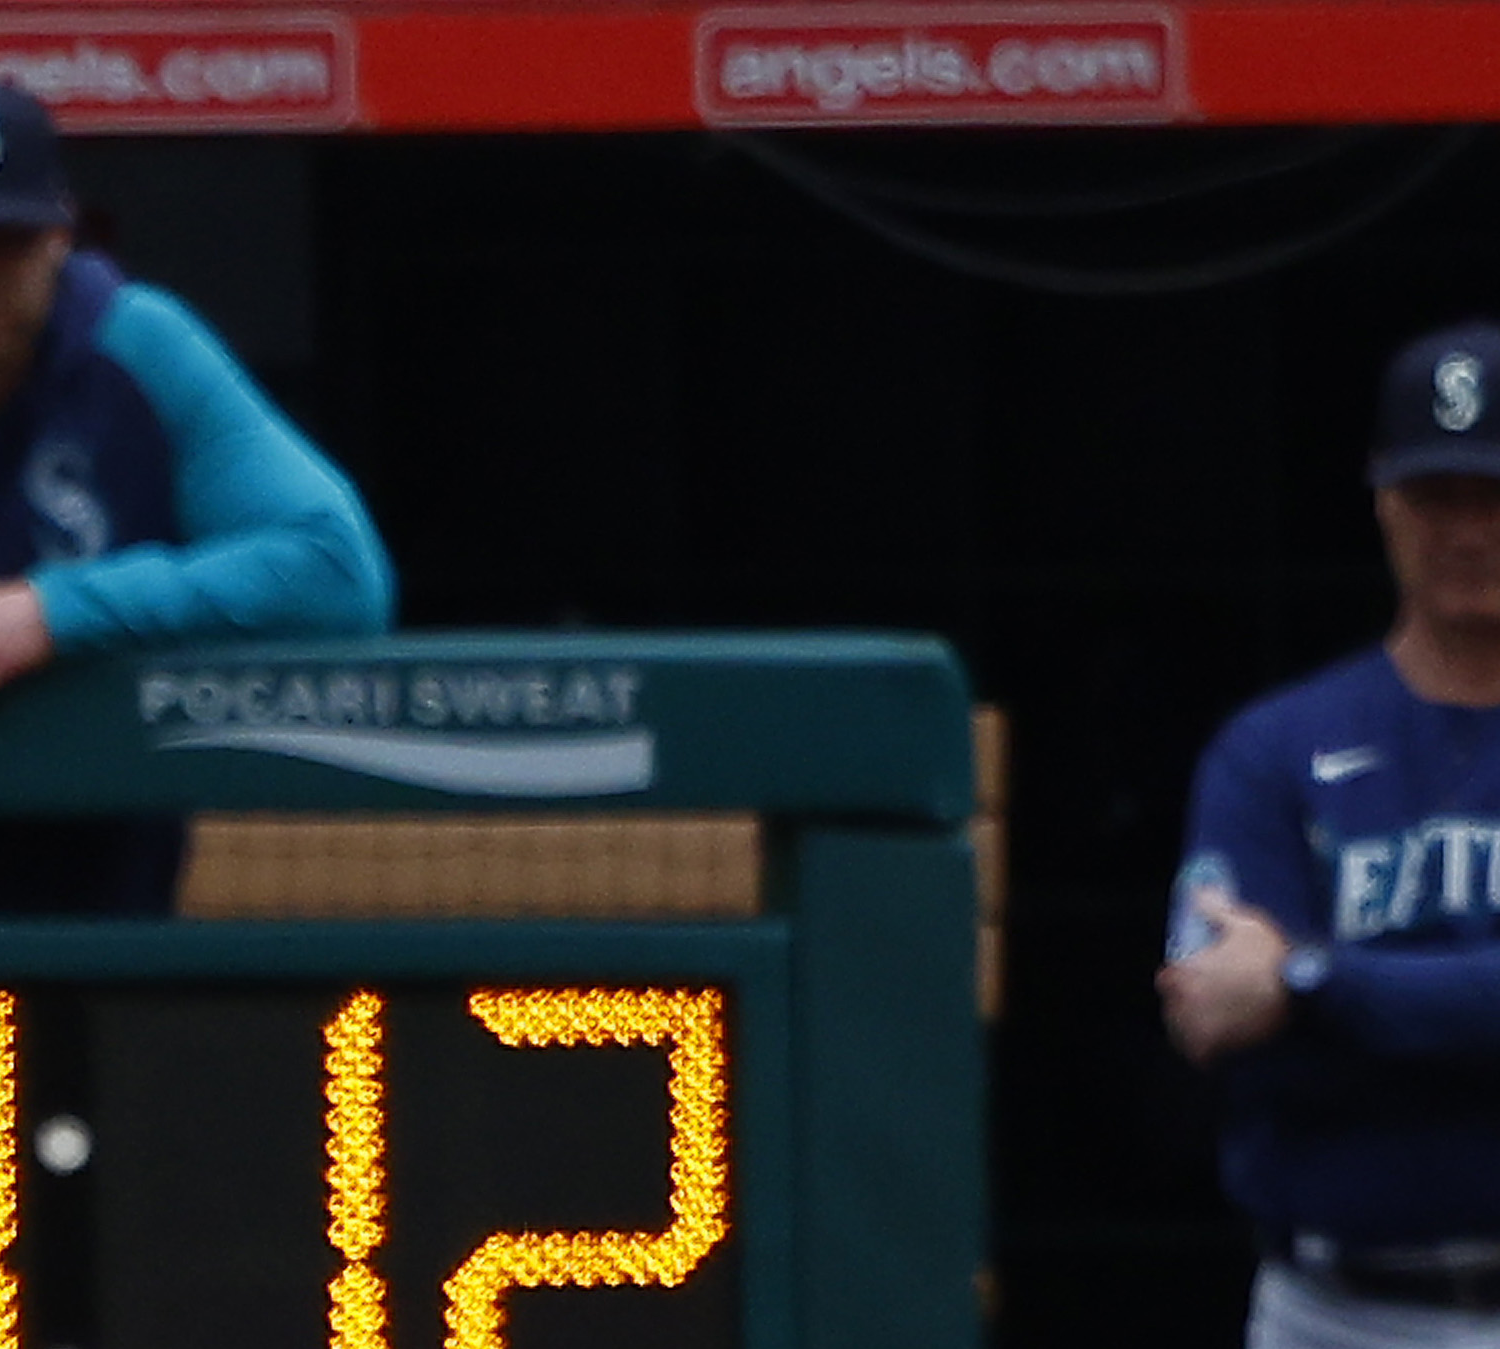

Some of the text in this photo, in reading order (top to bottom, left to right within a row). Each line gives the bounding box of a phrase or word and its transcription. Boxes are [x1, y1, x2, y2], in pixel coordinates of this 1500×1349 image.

[721, 38, 1155, 112] angels.com
[1433, 353, 1481, 432] S
[140, 668, 640, 726] POCARI SWEAT
